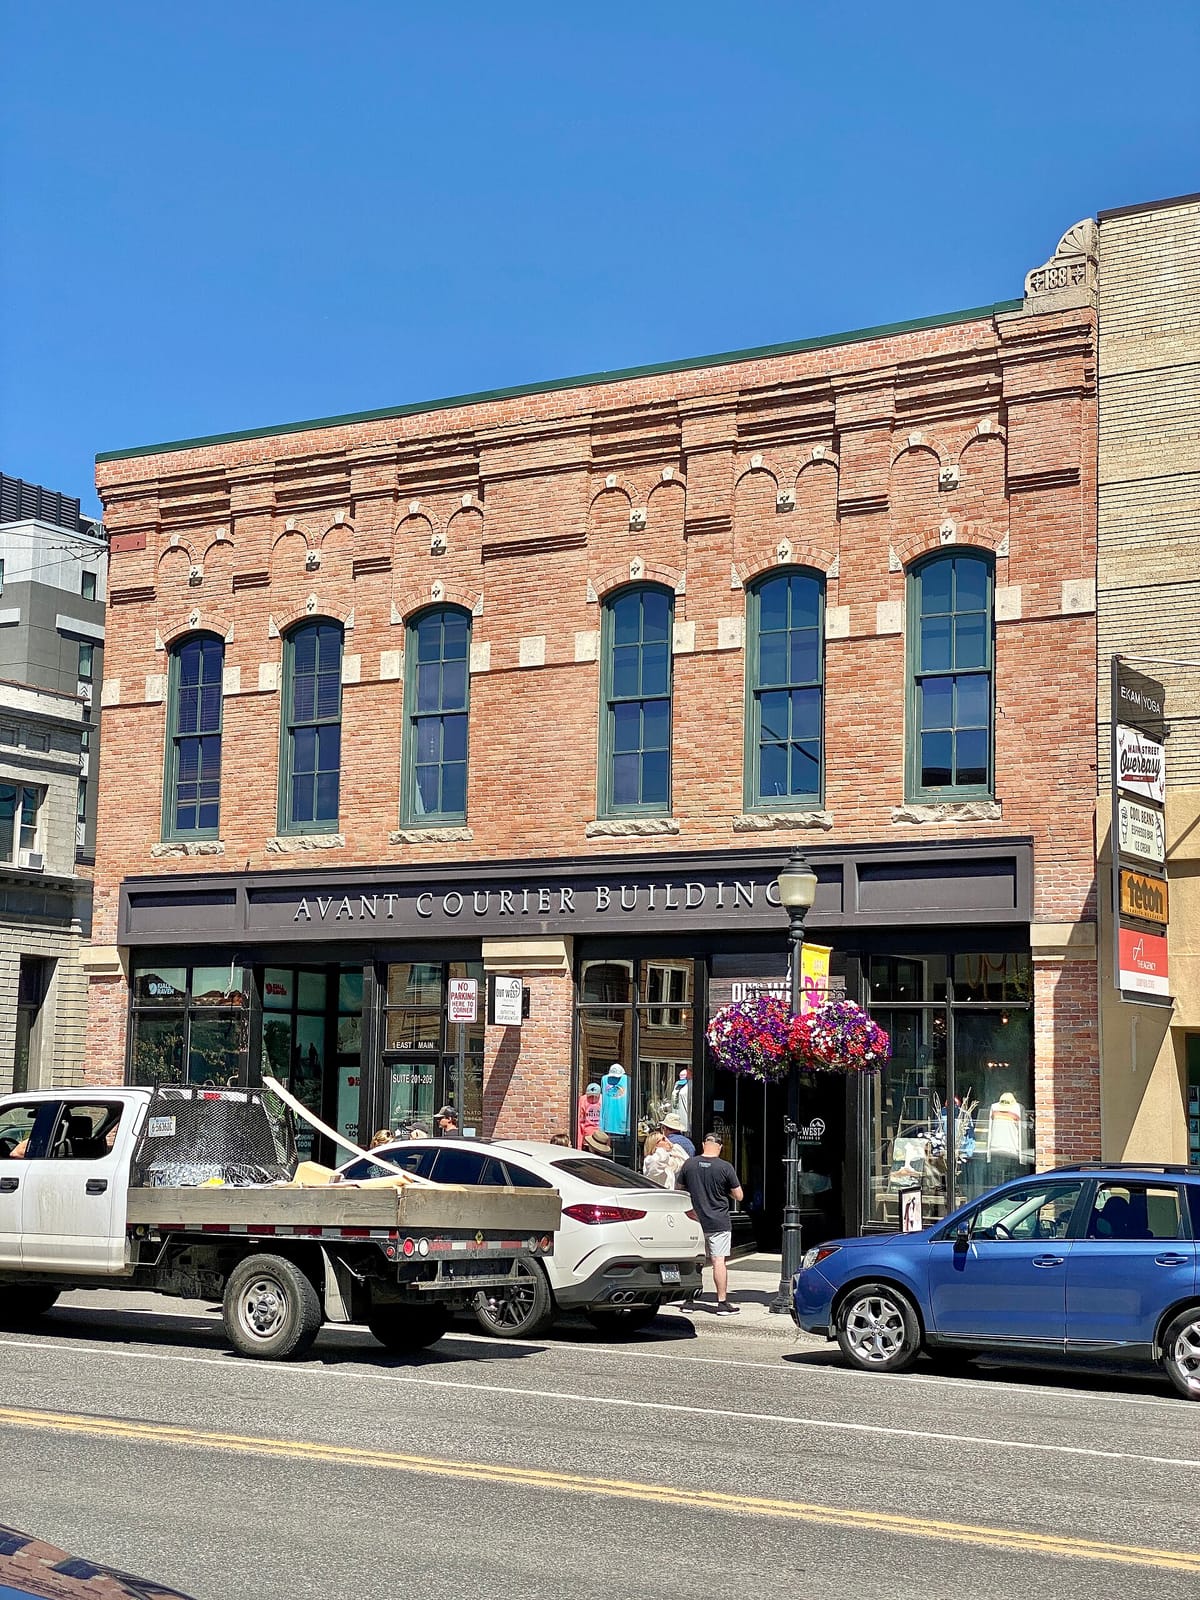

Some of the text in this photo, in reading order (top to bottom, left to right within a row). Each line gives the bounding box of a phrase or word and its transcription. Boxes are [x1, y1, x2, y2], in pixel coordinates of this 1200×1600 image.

[1120, 686, 1161, 714] EKAM YOGA
[1127, 744, 1160, 756] MAIN STREET
[1120, 748, 1161, 782] Overeasy
[1141, 810, 1154, 827] BEANS
[294, 894, 399, 920] AVANT
[416, 888, 576, 918] COURIER
[457, 982, 469, 991] NO
[450, 992, 475, 1001] PARKING
[496, 988, 519, 999] OUT WEST
[396, 1041, 412, 1049] EAST
[418, 1041, 434, 1049] MAIN
[393, 1074, 433, 1084] SUITE 201-205
[802, 1127, 822, 1136] WEST
